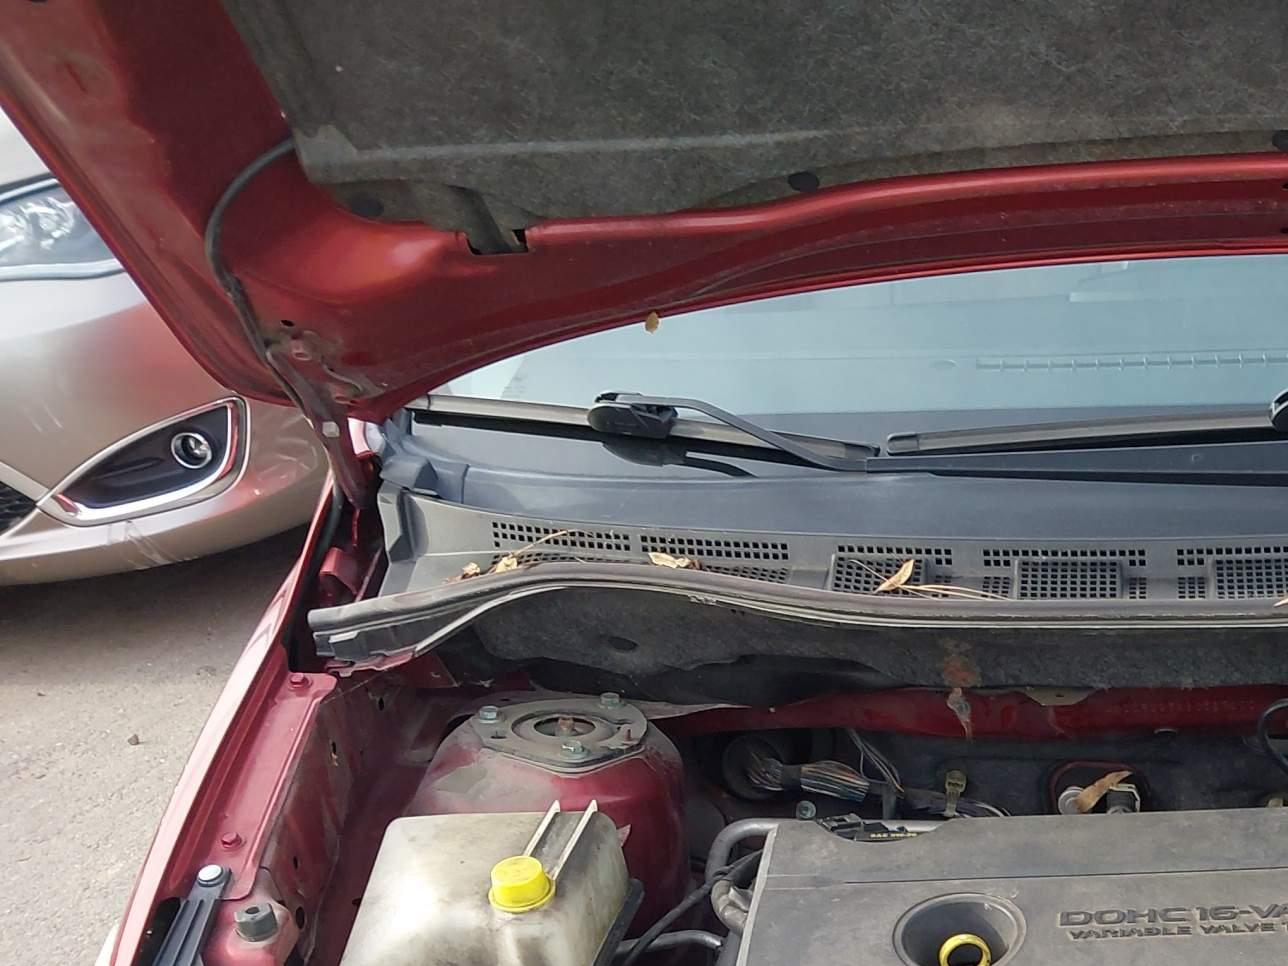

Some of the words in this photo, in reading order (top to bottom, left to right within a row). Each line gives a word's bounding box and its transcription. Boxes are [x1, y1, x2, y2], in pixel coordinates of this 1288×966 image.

[1060, 907, 1192, 926] DOHC
[1068, 925, 1193, 940] VARIABLE
[1200, 921, 1276, 934] VALVE
